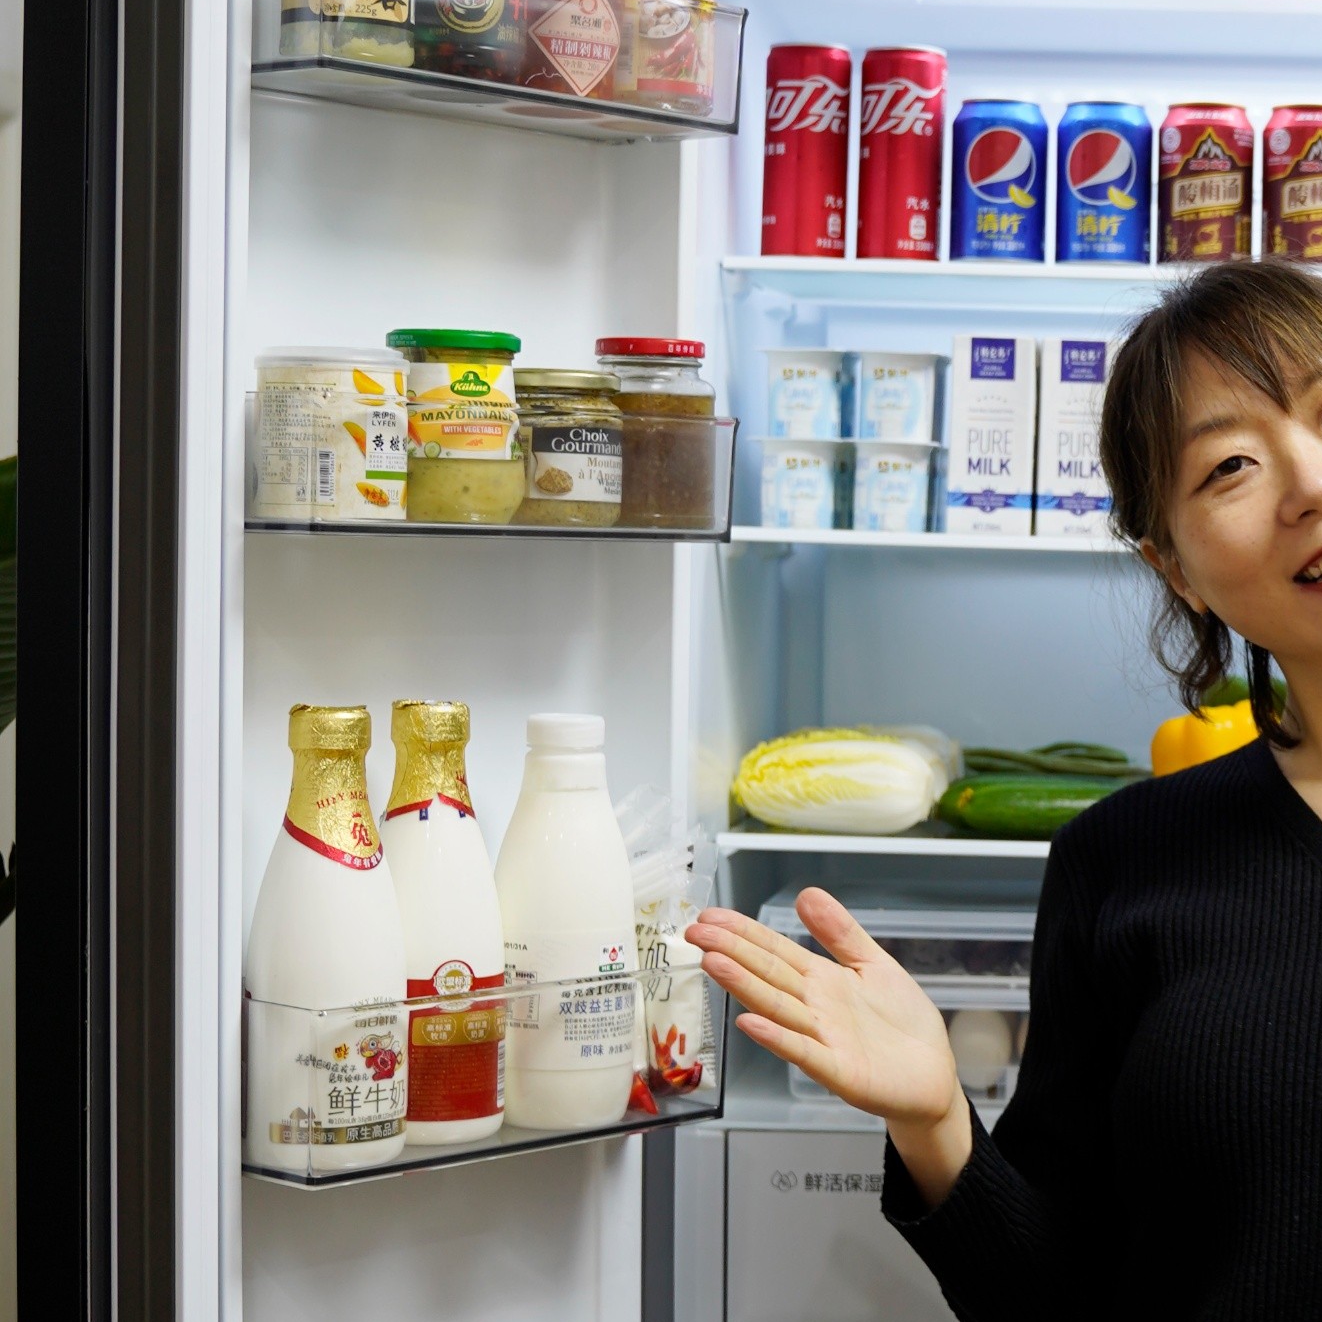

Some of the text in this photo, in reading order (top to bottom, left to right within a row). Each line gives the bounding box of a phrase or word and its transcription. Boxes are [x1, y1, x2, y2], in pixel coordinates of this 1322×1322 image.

[453, 383, 489, 392] Kühne
[372, 410, 396, 421] 来伊份
[420, 409, 513, 422] MAYONNAISE
[371, 420, 397, 428] LYFEN
[443, 425, 502, 435] WITH VEGETABLES
[569, 428, 609, 443] Choix
[967, 429, 1013, 455] PURE
[587, 457, 621, 468] Moutar
[967, 458, 1011, 476] MILK
[1058, 461, 1102, 479] MILK
[581, 1044, 605, 1058] 原味
[328, 1079, 405, 1116] 鲜牛奶
[804, 1173, 883, 1193] 鲜活保湿
